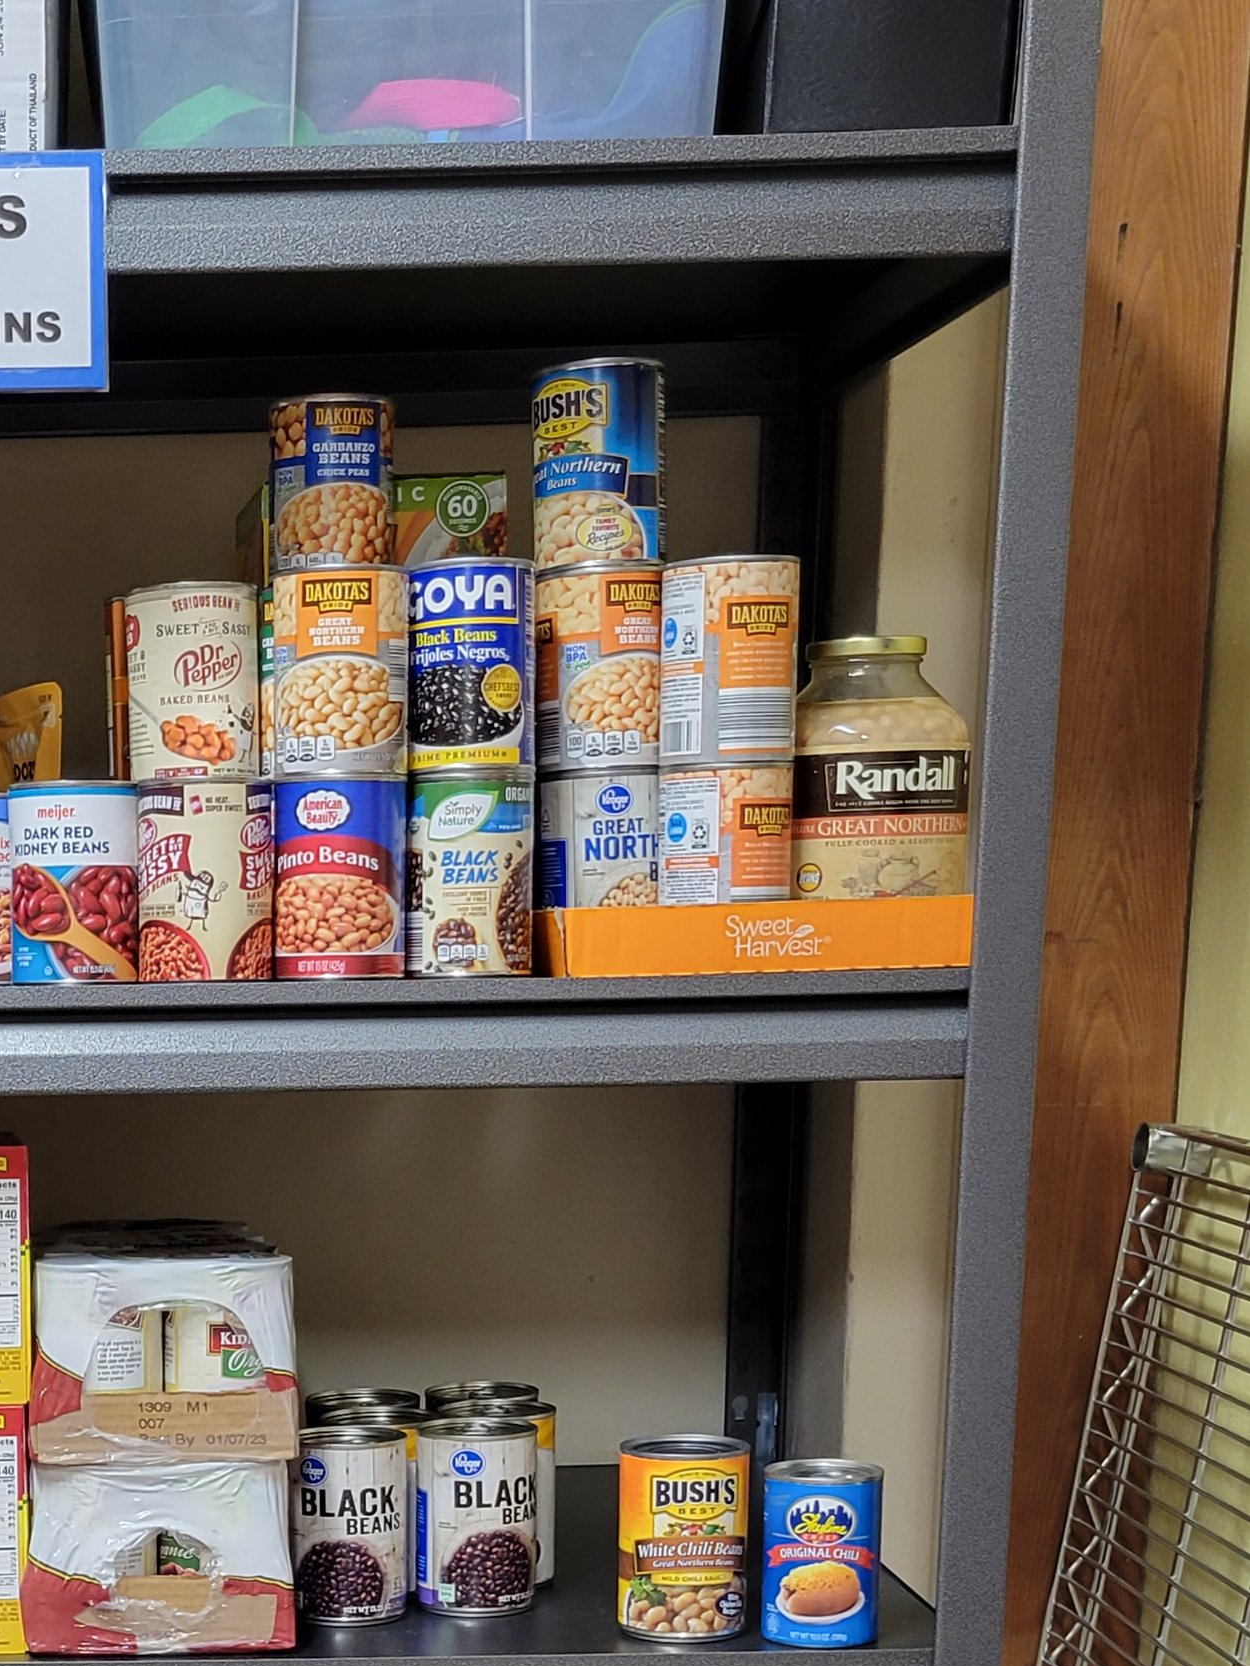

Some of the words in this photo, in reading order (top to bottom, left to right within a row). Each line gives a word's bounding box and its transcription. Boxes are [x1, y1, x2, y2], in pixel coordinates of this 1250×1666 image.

[315, 407, 375, 426] DAKOTA'S
[533, 387, 604, 429] BUSH'S
[313, 442, 375, 453] GARBANZO
[318, 453, 370, 464] BEANS
[551, 456, 622, 477] Northern
[547, 475, 577, 489] Beans
[448, 496, 476, 518] 60
[305, 580, 370, 601] DAKOTA'S
[317, 618, 353, 627] GREAT
[731, 604, 787, 624] DAKOTA'S
[309, 626, 365, 636] NORTHERN
[415, 630, 452, 648] Black
[454, 628, 497, 644] Beans
[313, 635, 361, 647] BEANS
[159, 695, 194, 707] BAKED
[197, 694, 230, 705] BEANS
[836, 755, 955, 800] Randall
[37, 806, 75, 820] meijer
[301, 796, 343, 814] American
[444, 803, 483, 823] Simply
[438, 814, 475, 827] Nature
[592, 818, 644, 836] GREAT
[24, 826, 60, 841] DARK
[64, 826, 94, 839] RED
[14, 841, 60, 857] KIDNEY
[62, 840, 110, 855] BEANS
[277, 847, 315, 874] Pinto
[319, 846, 379, 872] Beans
[440, 850, 499, 869] BLACK
[442, 866, 499, 884] BEANS
[725, 914, 795, 938] Sweet
[734, 935, 821, 958] Harvest
[138, 1418, 164, 1429] 007
[301, 1484, 395, 1518] BLACK
[655, 1477, 736, 1507] BUSH'S
[678, 1507, 716, 1515] BEST
[346, 1513, 401, 1535] BEANS
[638, 1543, 674, 1558] White
[677, 1541, 713, 1557] Chili
[716, 1543, 743, 1556] Beans
[780, 1547, 831, 1559] ORIGINAL
[833, 1548, 860, 1561] CHILI
